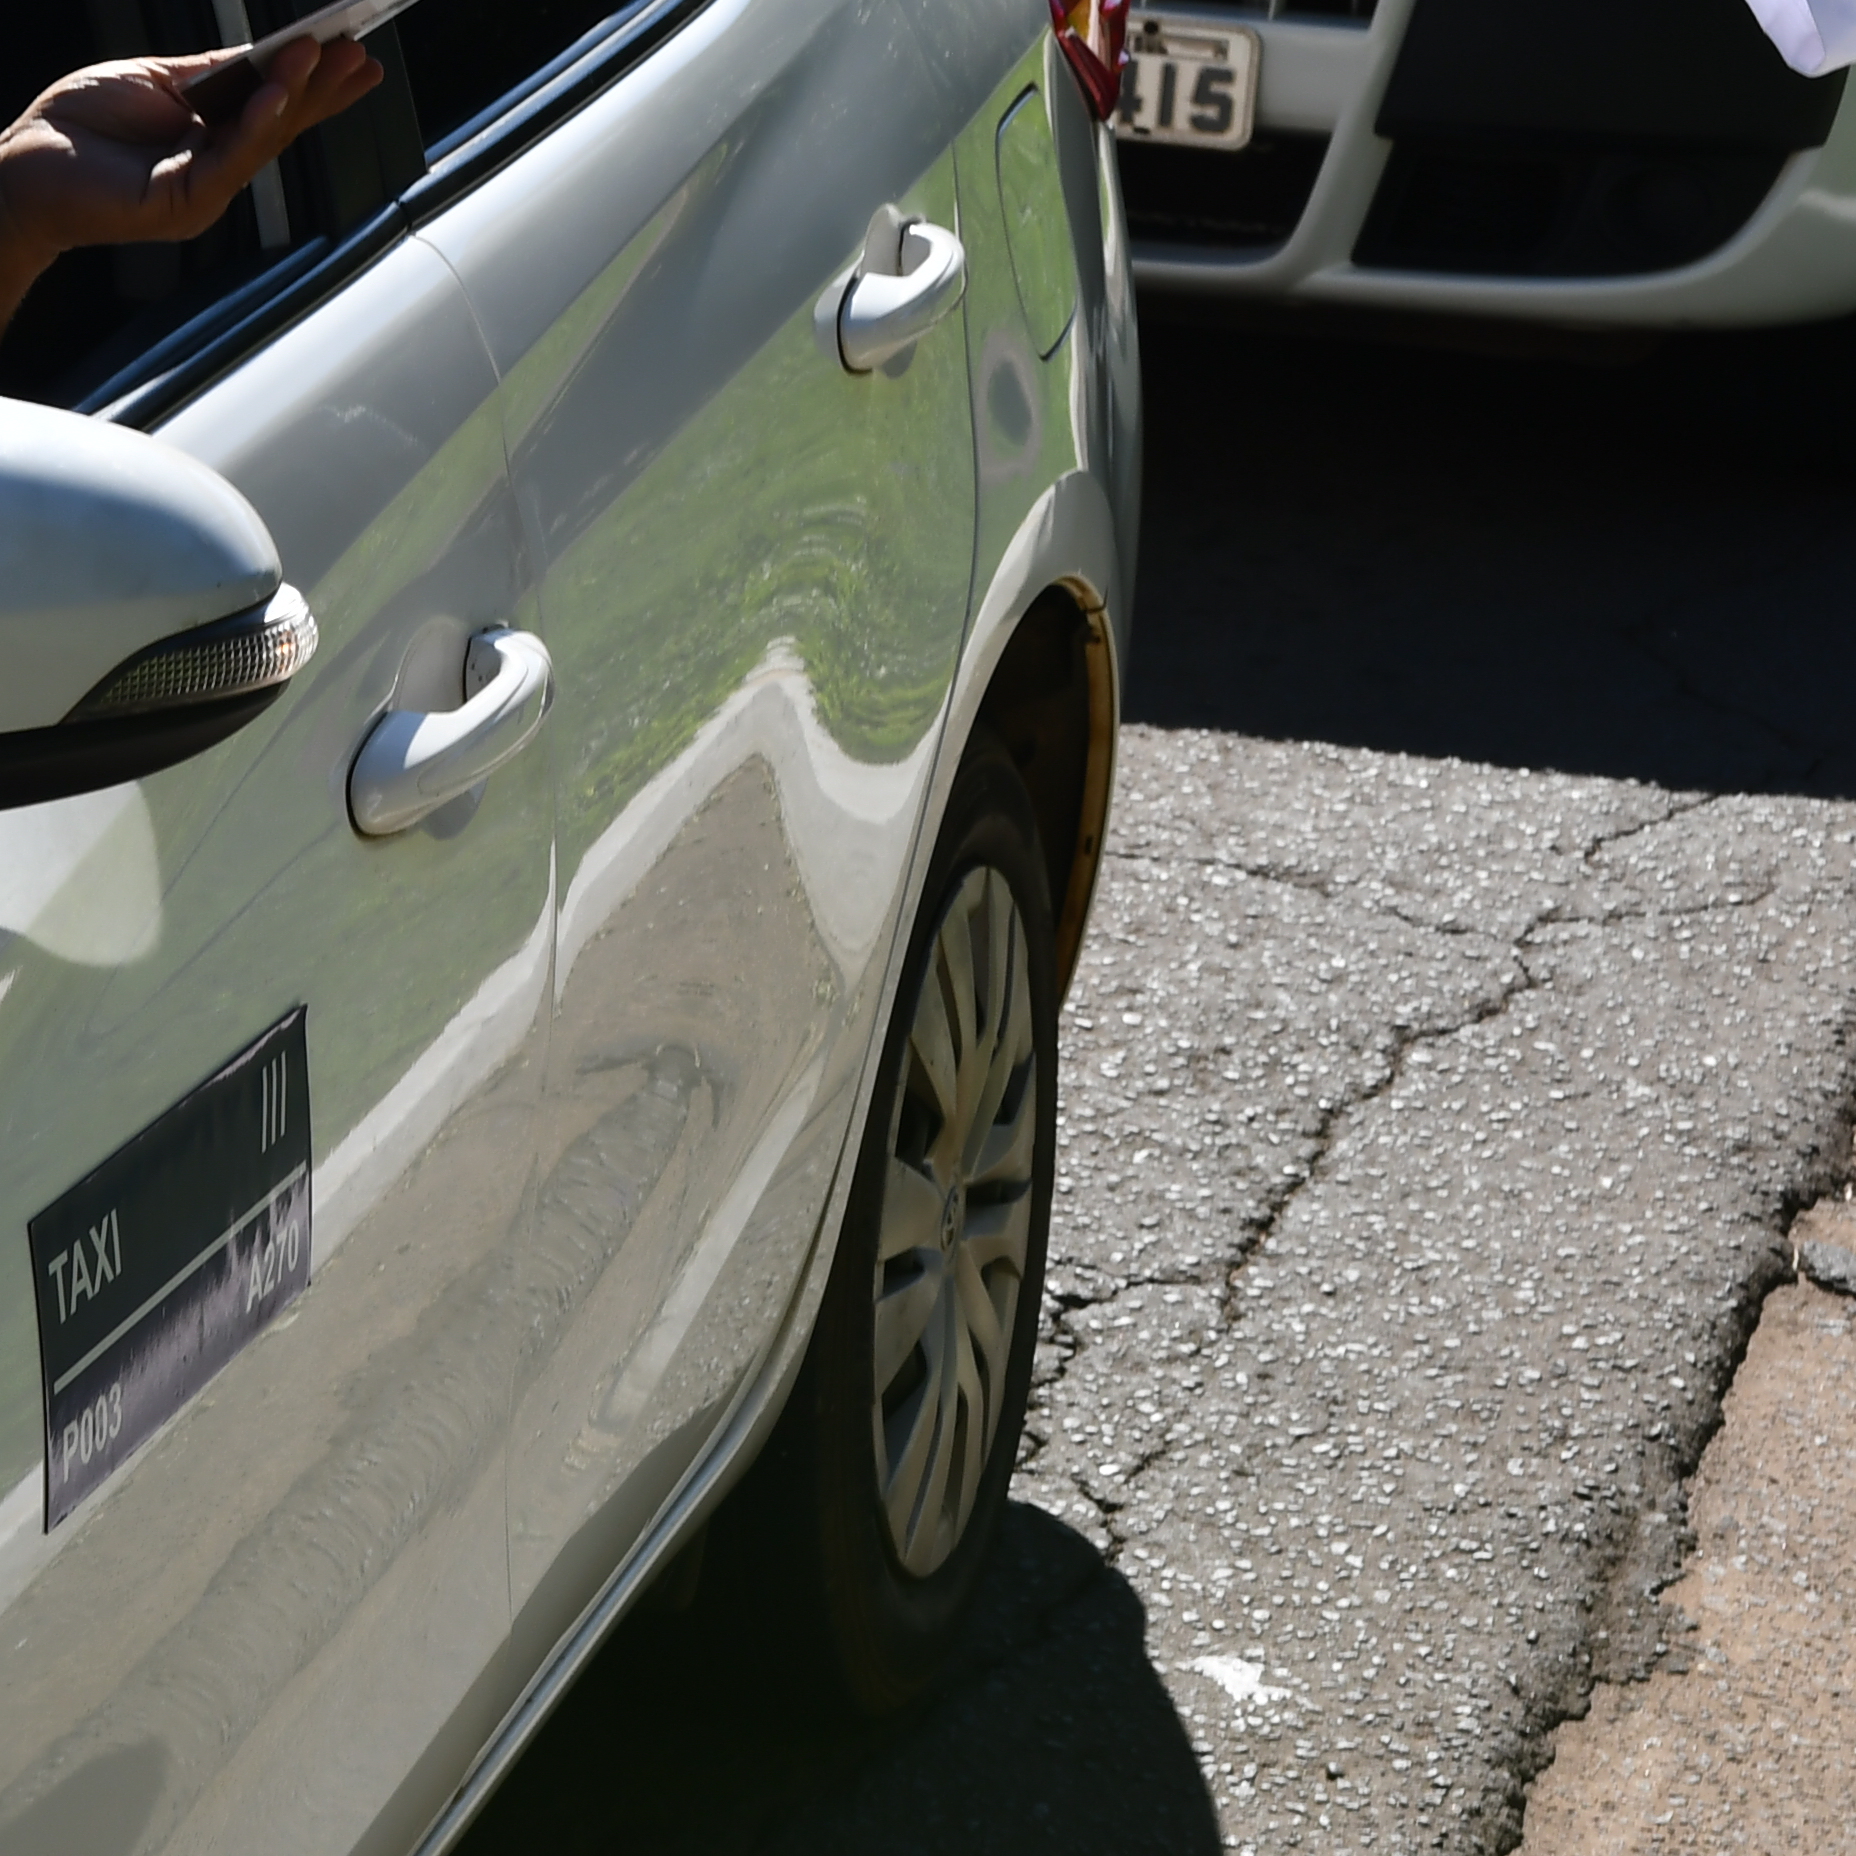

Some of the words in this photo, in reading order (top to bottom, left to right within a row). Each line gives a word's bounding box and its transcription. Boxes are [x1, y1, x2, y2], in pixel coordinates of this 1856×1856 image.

[48, 1207, 123, 1324] TAXI
[246, 1219, 300, 1315] A270
[62, 1381, 123, 1485] P003
